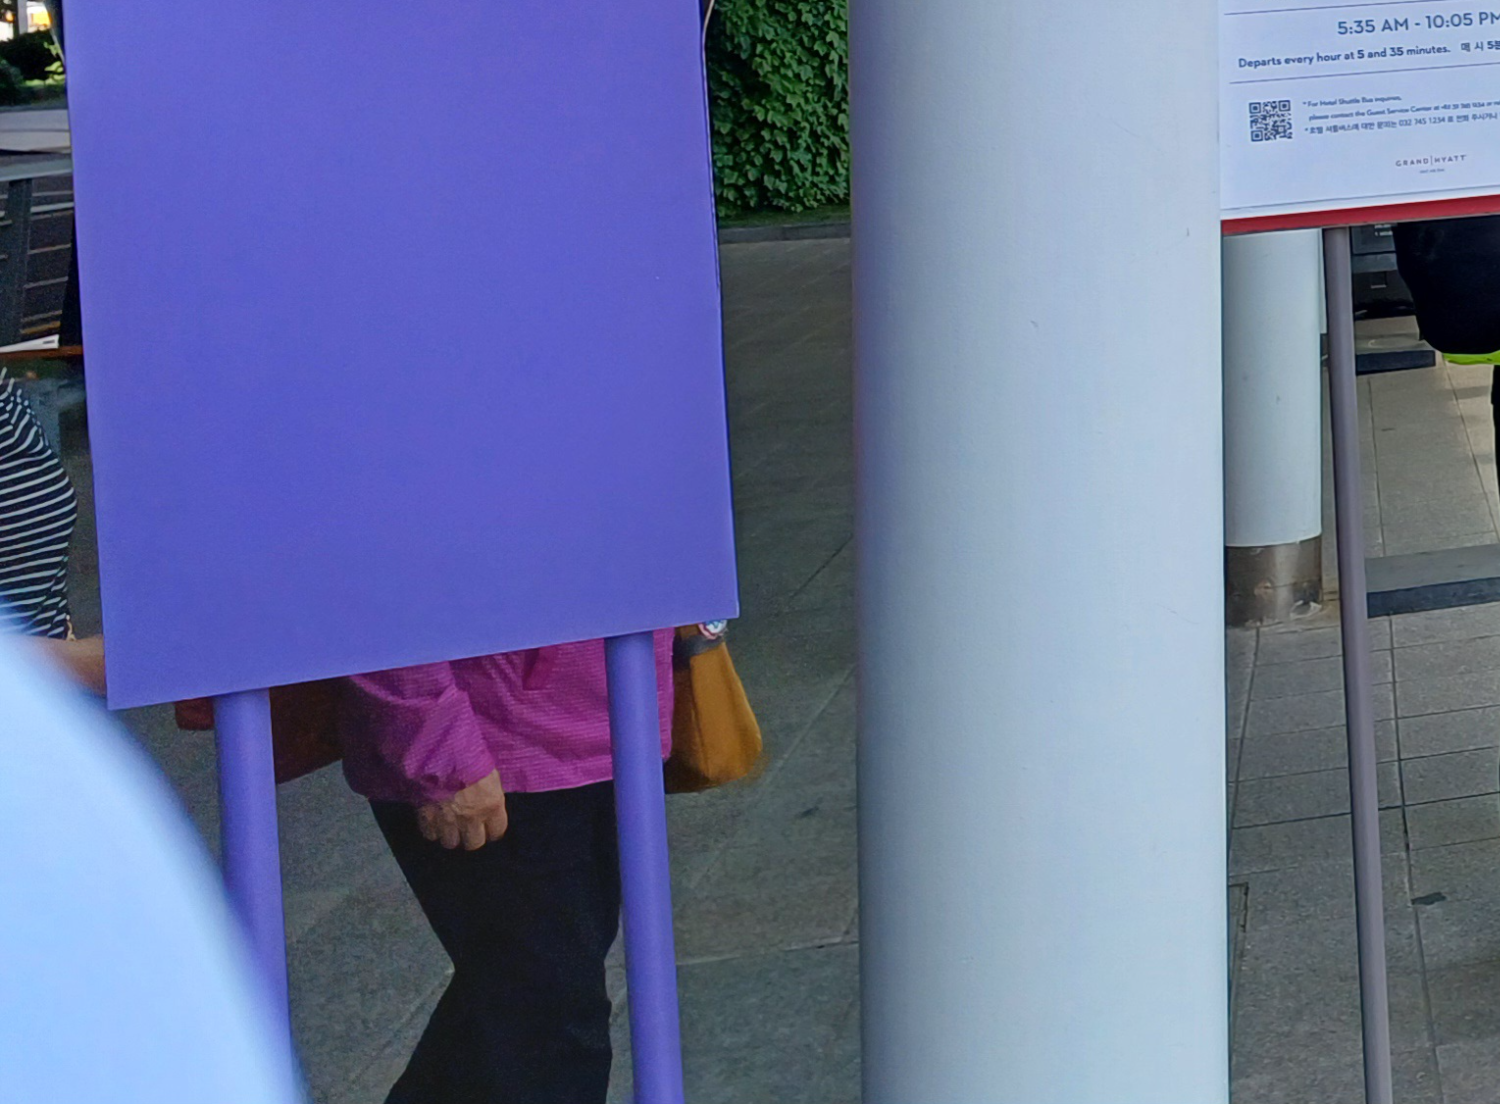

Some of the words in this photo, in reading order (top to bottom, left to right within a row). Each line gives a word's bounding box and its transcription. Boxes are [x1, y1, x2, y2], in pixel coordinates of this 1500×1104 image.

[1337, 19, 1376, 35] 5:35
[1381, 17, 1409, 33] AM
[1425, 12, 1473, 29] 10:05
[1238, 57, 1282, 69] Departs
[1284, 54, 1314, 66] every
[1316, 52, 1341, 63] hour
[1344, 51, 1355, 60] at
[1357, 49, 1365, 59] 5
[1367, 47, 1387, 58] and
[1389, 46, 1404, 57] 35
[1406, 43, 1451, 56] minutes.
[1474, 41, 1484, 51] 시
[1429, 116, 1445, 124] 1234
[1395, 157, 1429, 167] GRAND
[1434, 154, 1467, 163] HYATT
